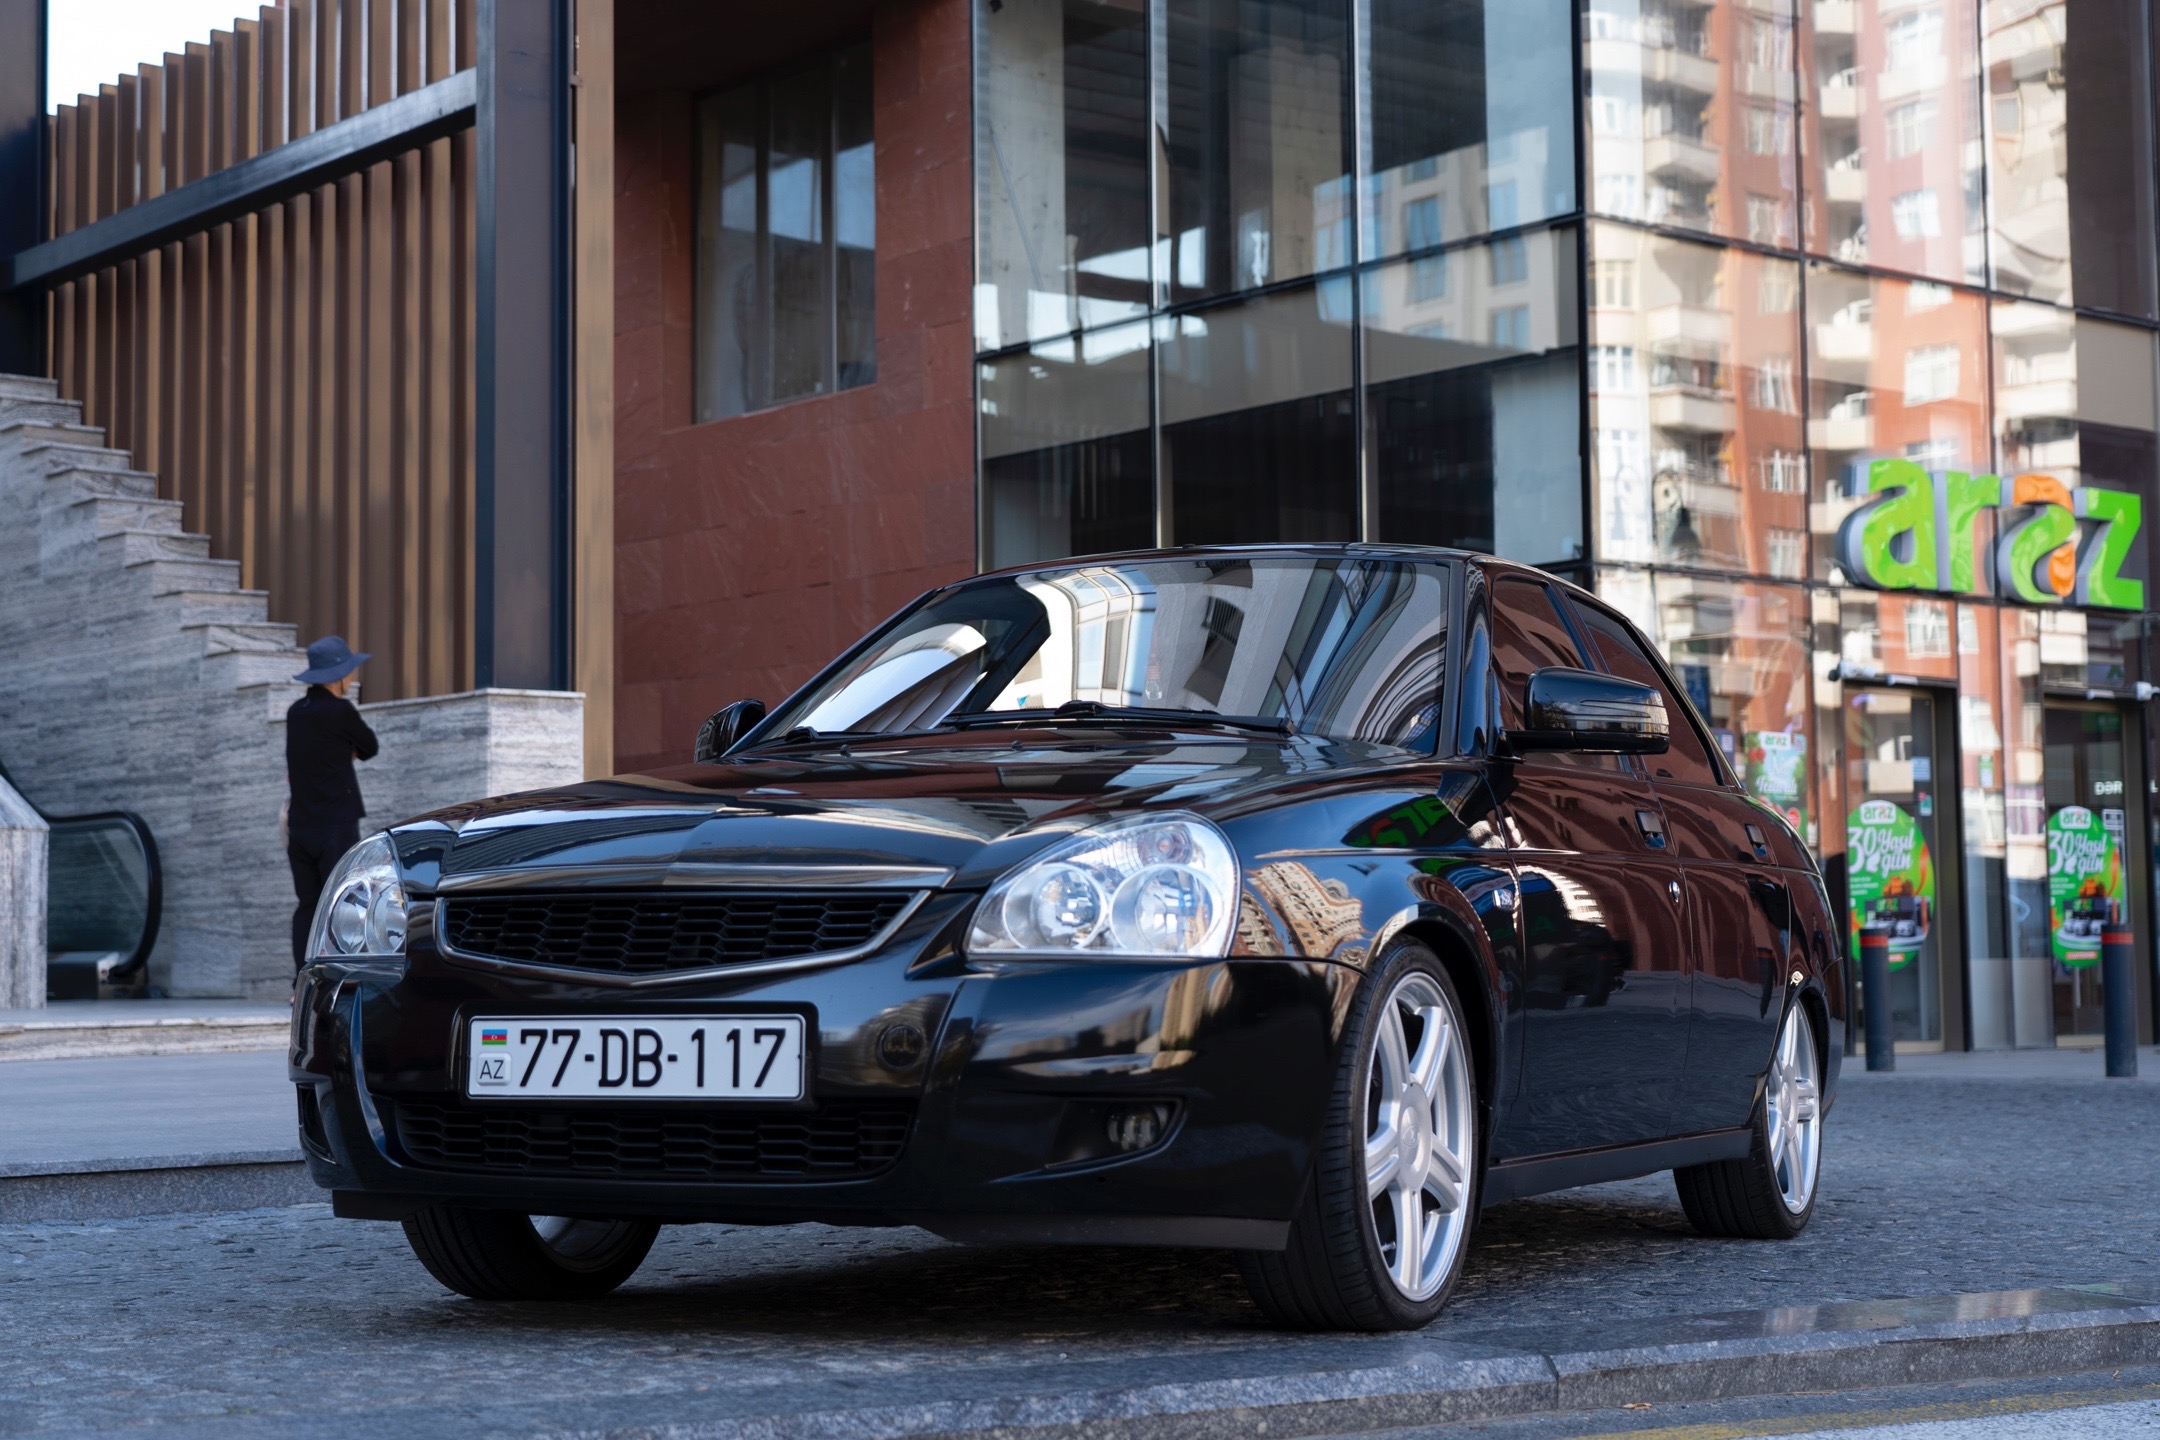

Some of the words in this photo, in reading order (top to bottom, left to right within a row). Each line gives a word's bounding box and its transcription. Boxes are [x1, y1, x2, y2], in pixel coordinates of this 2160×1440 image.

[1840, 458, 2144, 610] araz
[1863, 805, 1894, 820] araz
[2062, 811, 2090, 825] araz
[1848, 827, 1877, 874] 30
[2048, 830, 2074, 875] 30
[479, 1059, 504, 1080] AZ
[519, 1028, 786, 1088] 77-DB-117
